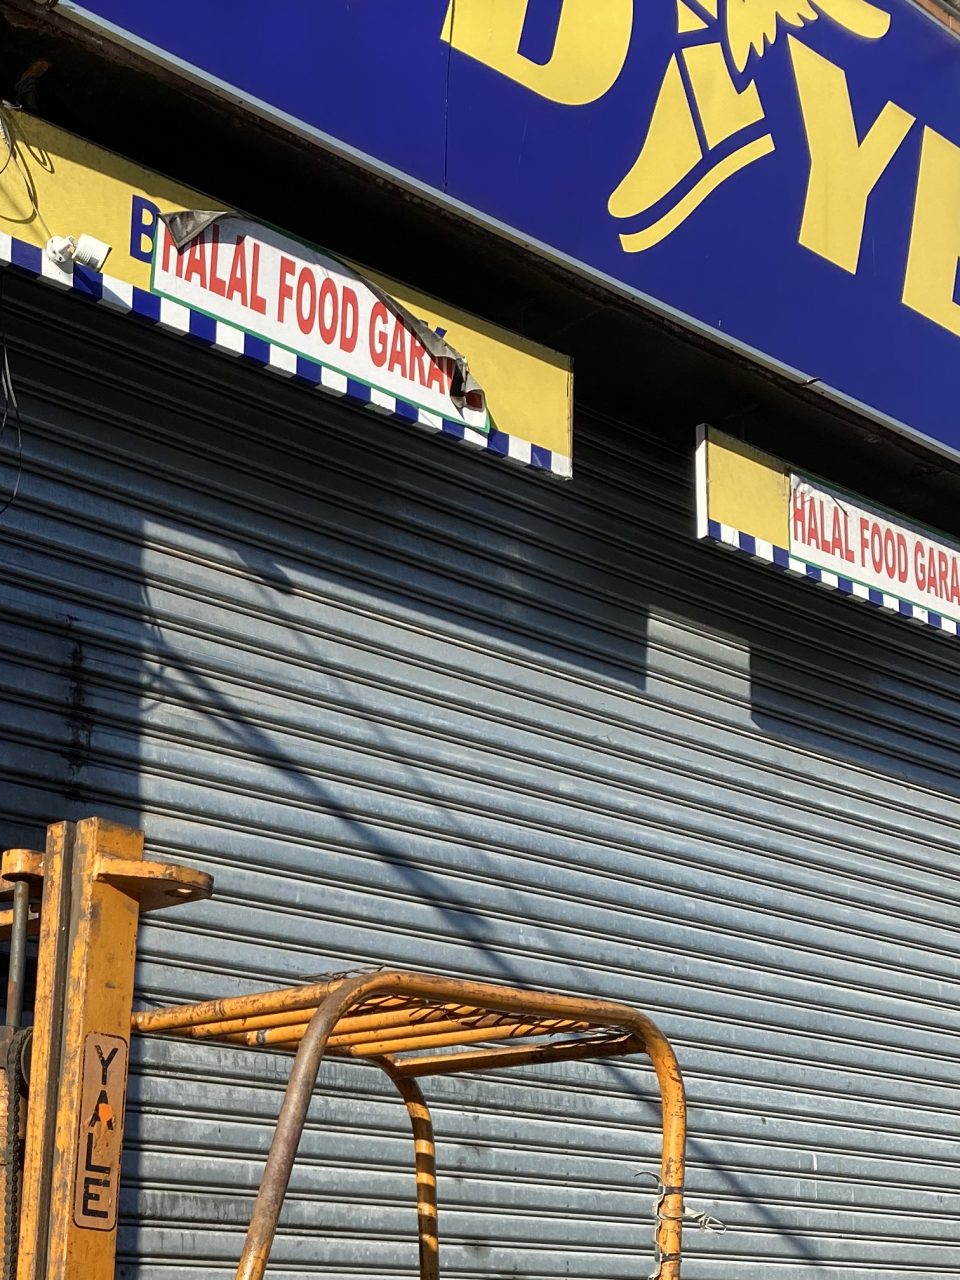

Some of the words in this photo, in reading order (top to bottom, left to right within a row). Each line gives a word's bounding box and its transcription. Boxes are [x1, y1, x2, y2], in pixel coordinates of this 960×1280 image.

[161, 224, 267, 315] HALAL
[277, 256, 359, 353] FOOD
[369, 301, 453, 396] GARA
[793, 488, 855, 564] HALAL
[860, 517, 909, 584] FOOD
[82, 1045, 118, 1219] YALE
